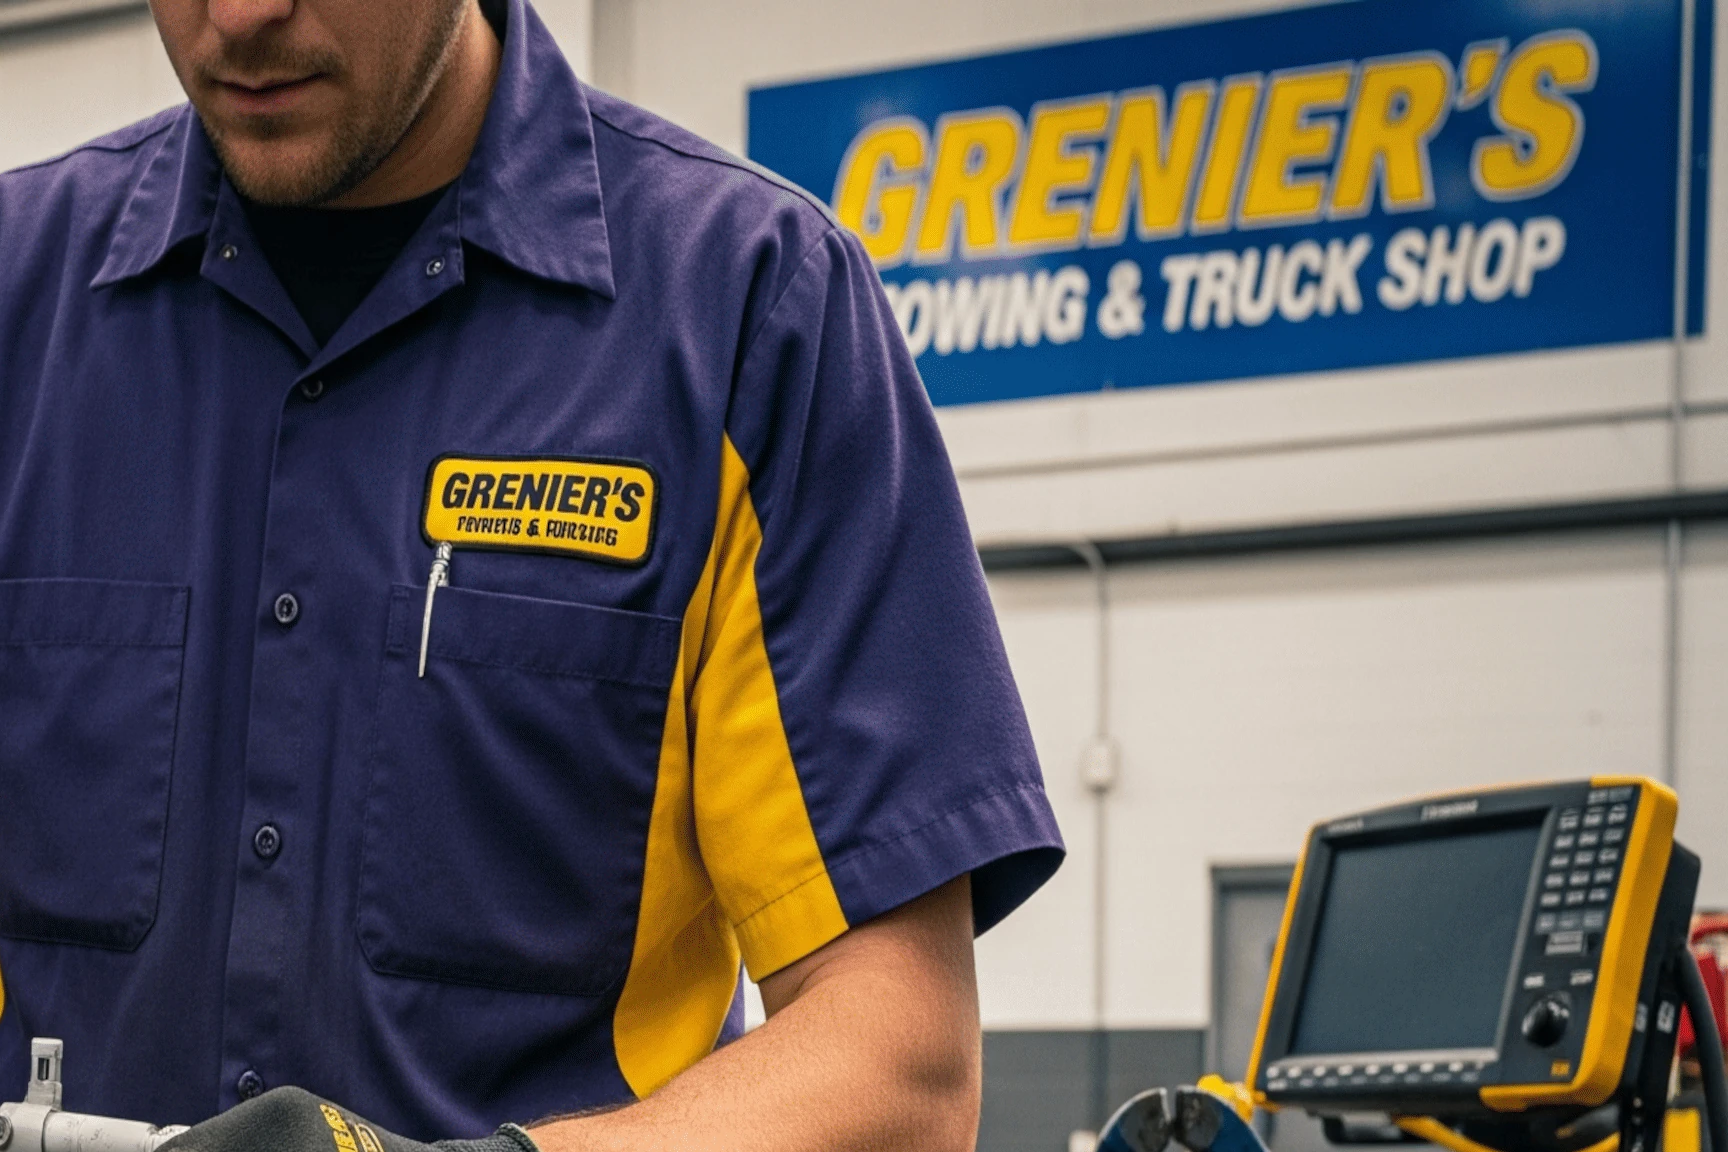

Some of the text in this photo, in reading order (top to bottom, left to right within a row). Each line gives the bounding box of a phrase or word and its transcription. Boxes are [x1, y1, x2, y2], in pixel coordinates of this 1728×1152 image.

[833, 30, 1598, 266] GRENIER'S
[1098, 260, 1144, 339] &
[1161, 236, 1373, 332] TRUCK
[1378, 216, 1567, 311] SHOP
[441, 472, 646, 523] GRENIER'S
